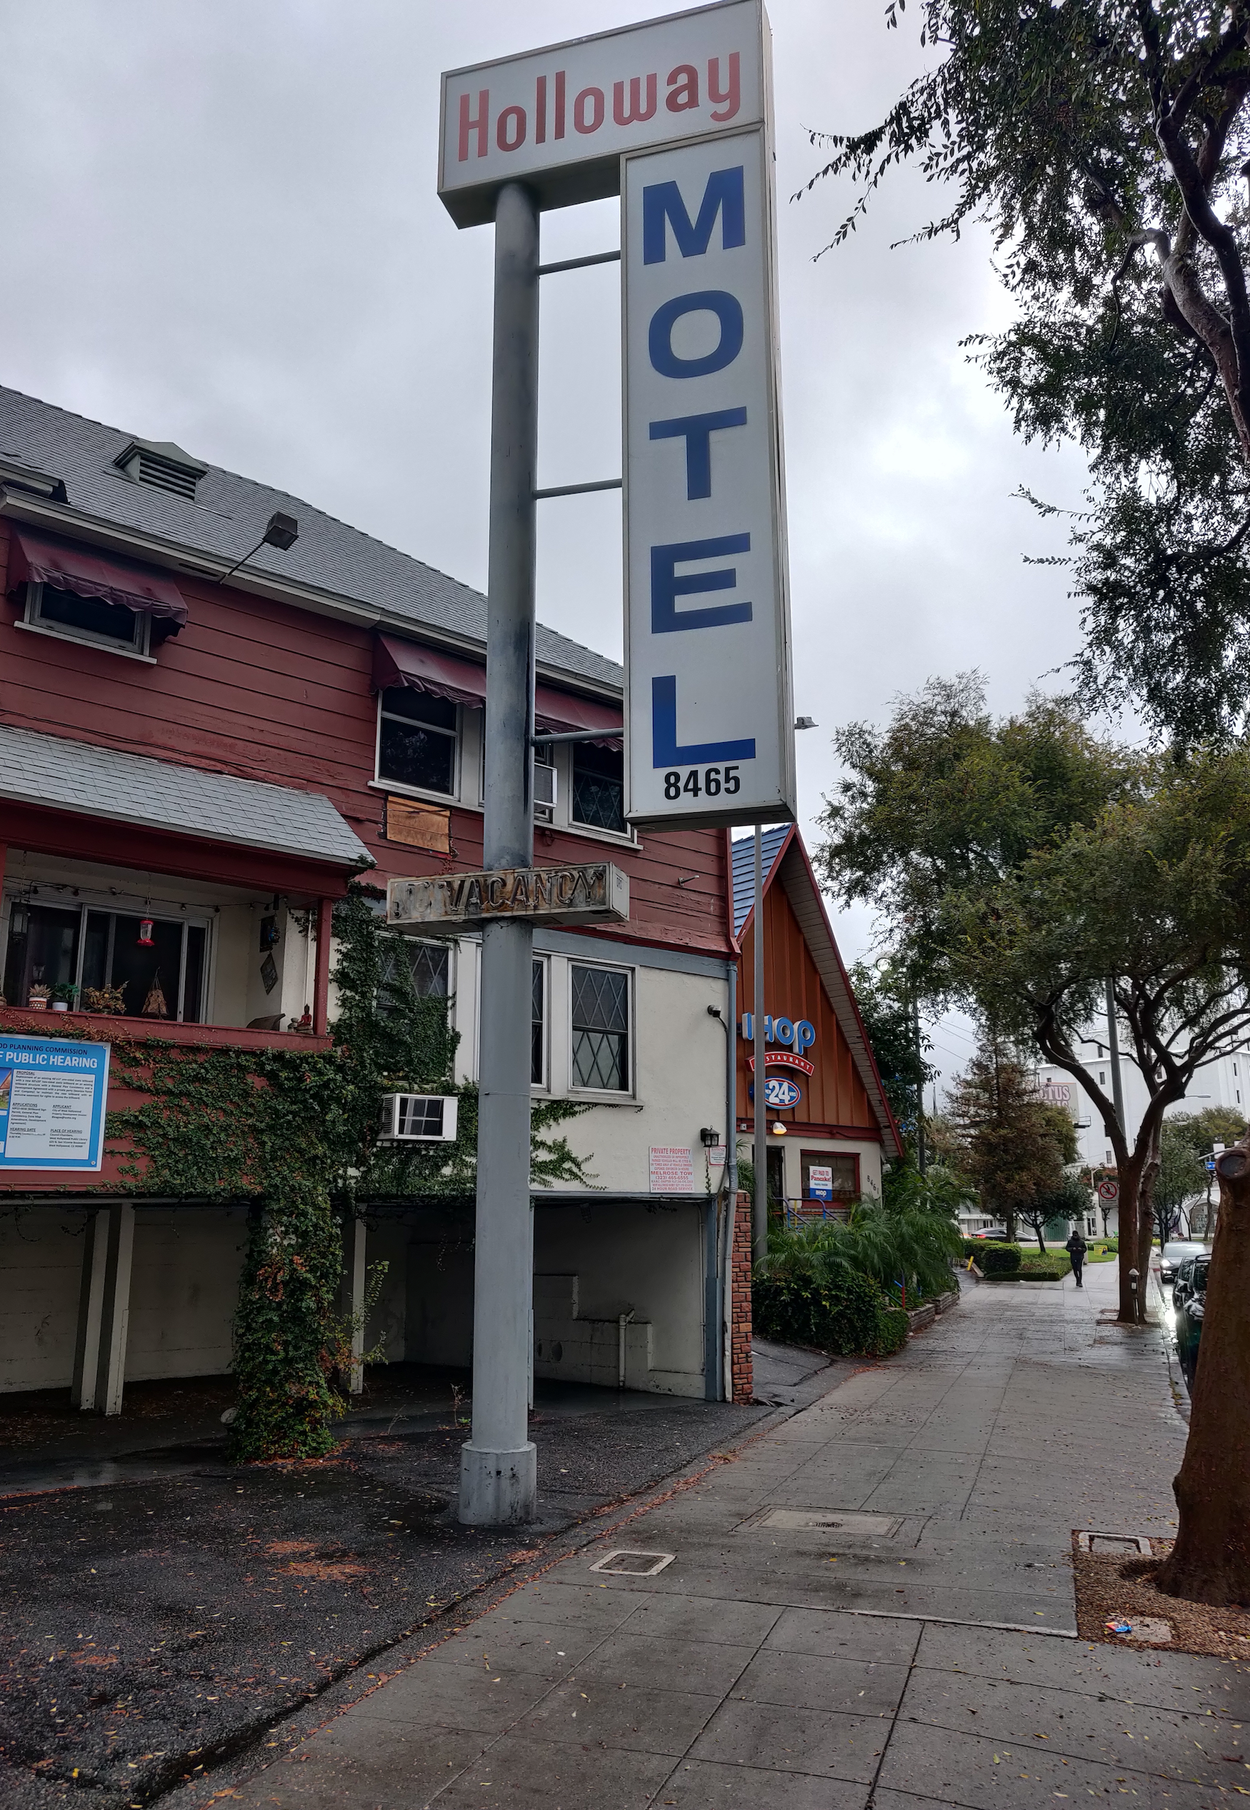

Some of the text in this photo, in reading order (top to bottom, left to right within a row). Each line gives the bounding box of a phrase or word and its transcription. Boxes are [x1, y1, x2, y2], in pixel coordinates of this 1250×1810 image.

[458, 51, 741, 162] Holloway
[642, 165, 756, 769] MOTEL
[664, 765, 741, 801] 8465
[443, 871, 603, 912] VACANCY
[5, 1051, 48, 1065] PUBLIC
[49, 1054, 98, 1069] HEARING
[9, 1043, 44, 1052] PLANNING
[45, 1046, 88, 1055] COMMISSION
[768, 1080, 791, 1105] 24
[651, 1147, 691, 1156] PRIVATE PROPERTY
